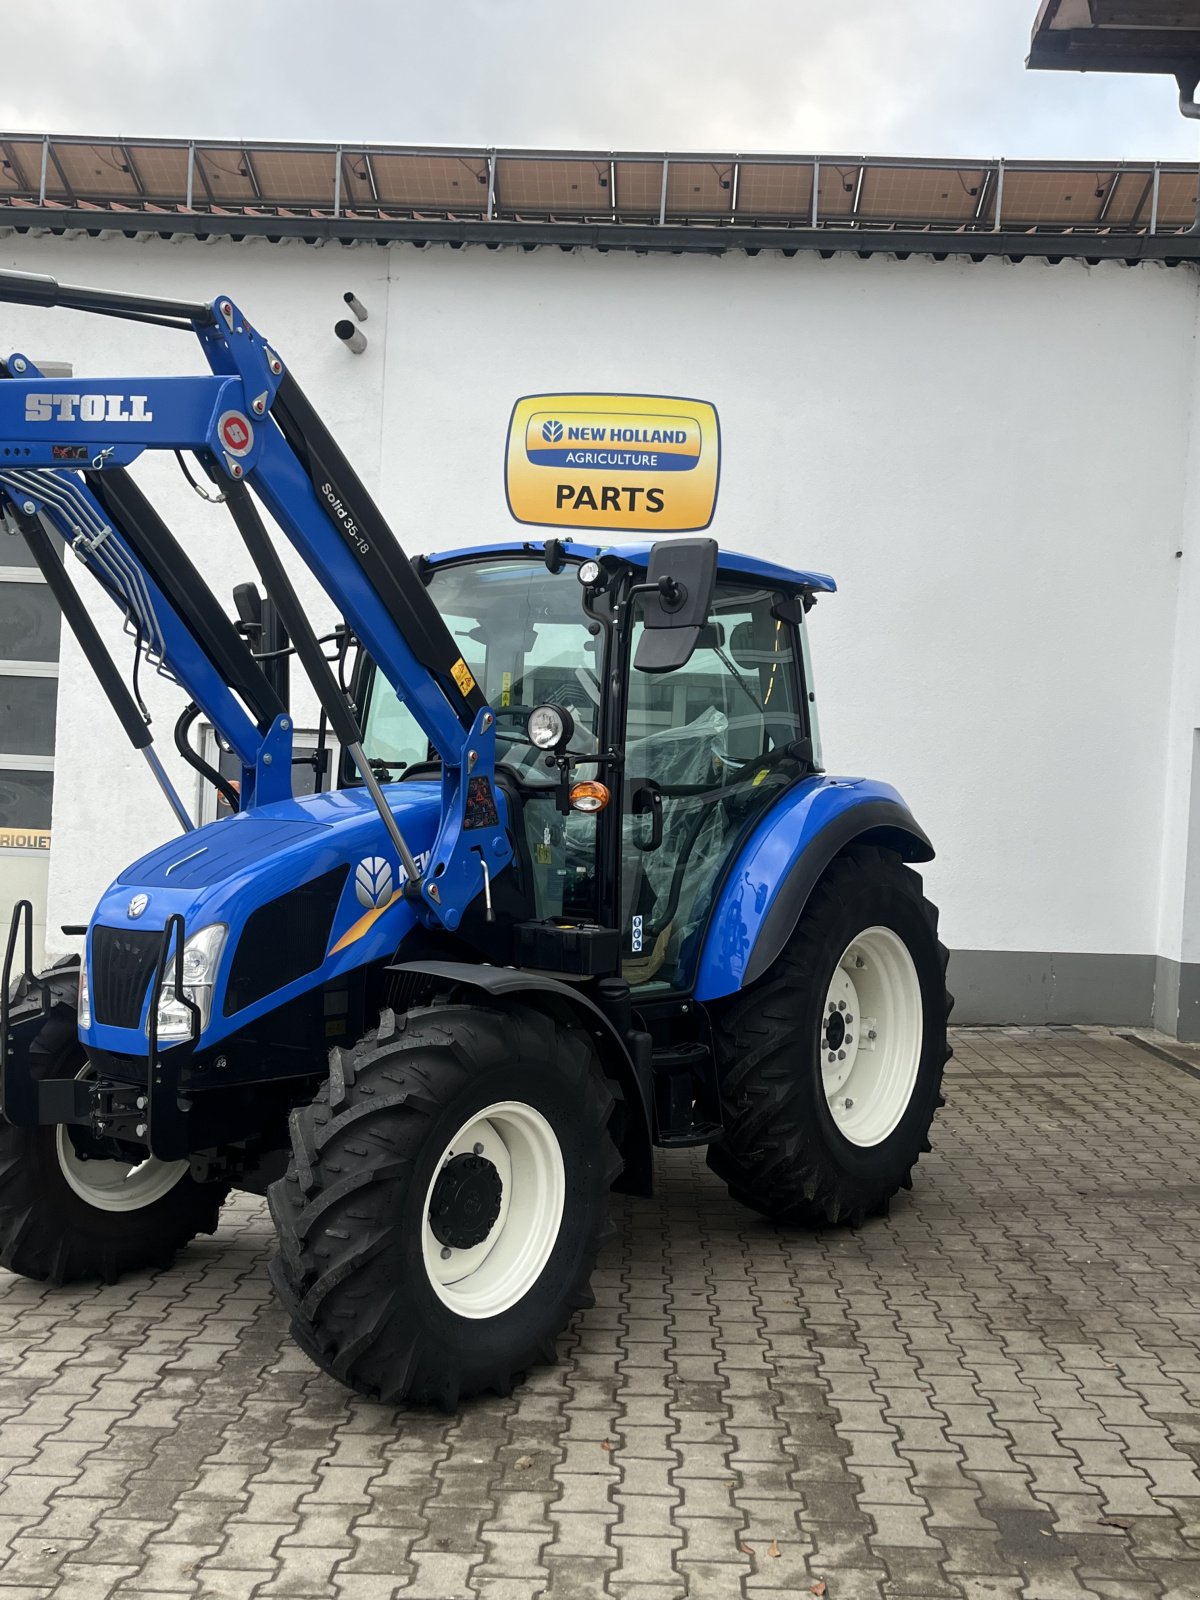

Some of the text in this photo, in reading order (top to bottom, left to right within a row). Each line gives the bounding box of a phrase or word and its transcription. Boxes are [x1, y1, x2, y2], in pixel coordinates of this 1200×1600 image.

[25, 393, 153, 422] STOLL
[568, 427, 687, 444] NEW HOLLAND
[565, 452, 658, 466] AGRICULTURE
[556, 484, 665, 513] PARTS
[321, 482, 370, 554] Solid 35-18
